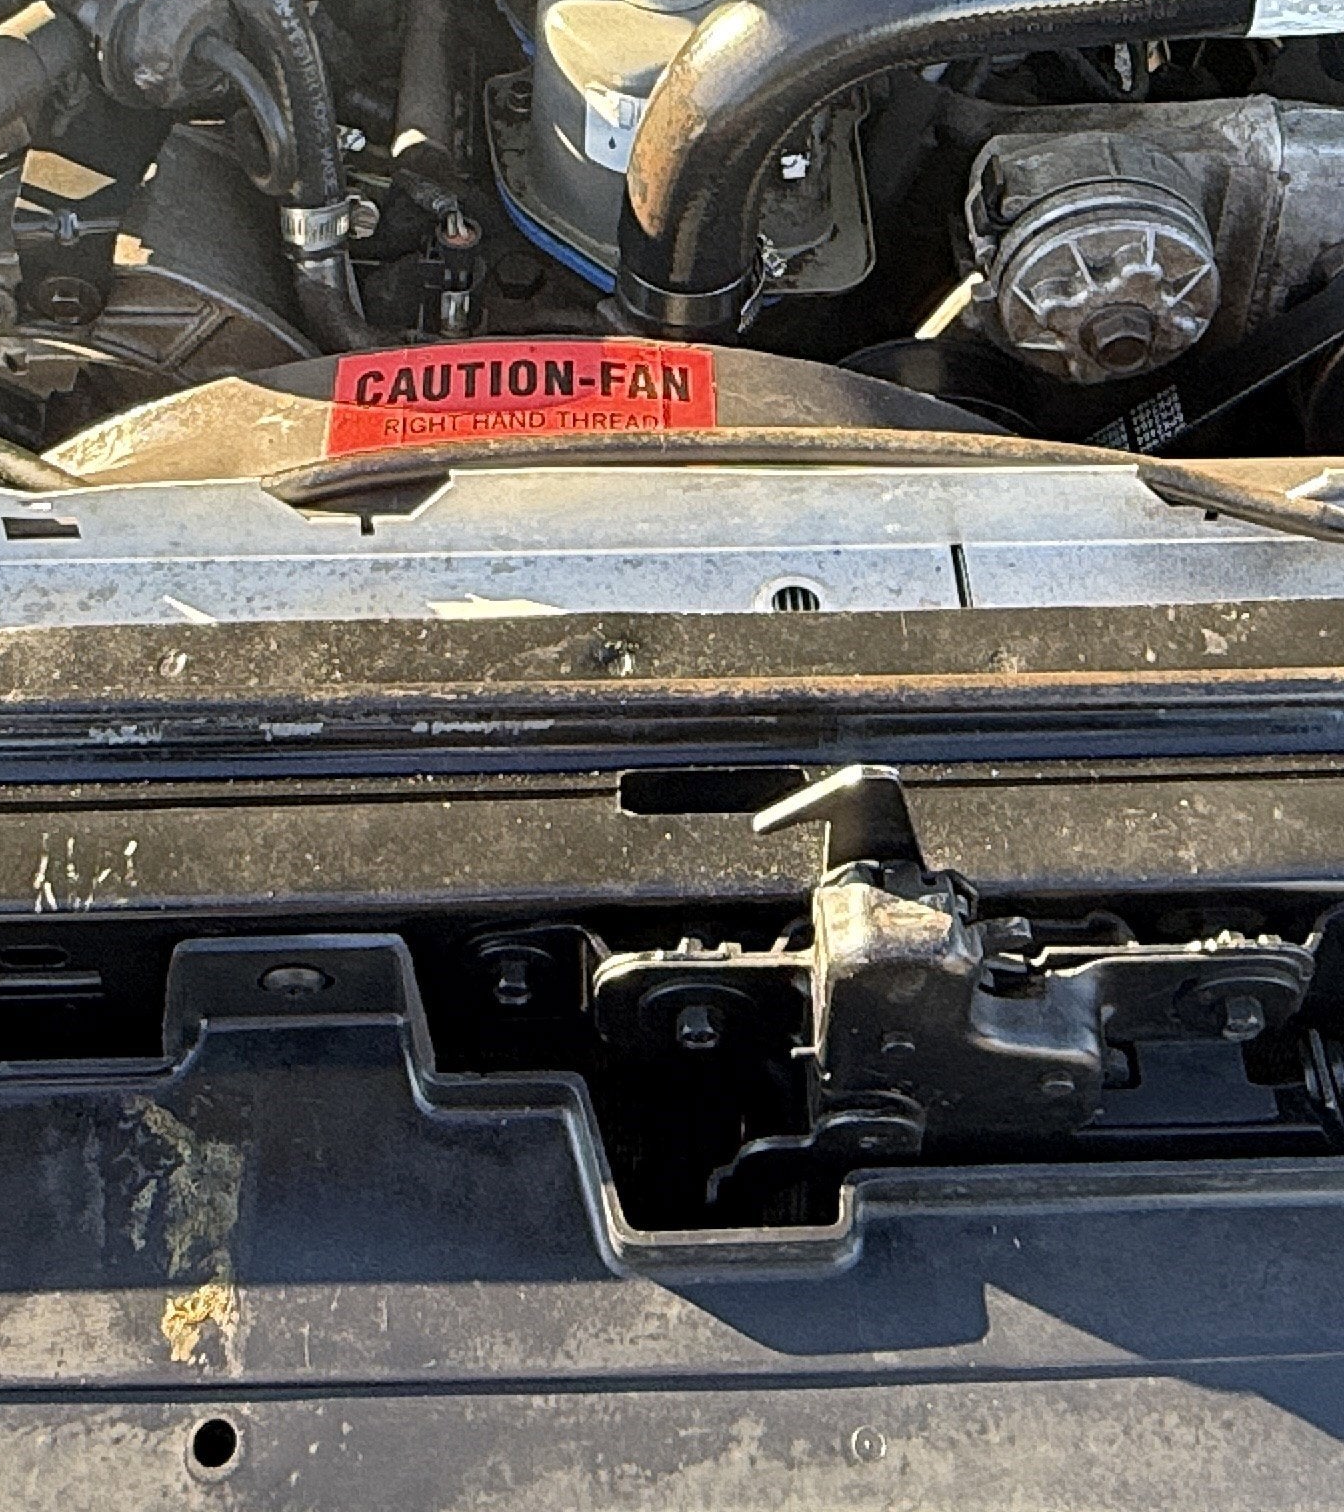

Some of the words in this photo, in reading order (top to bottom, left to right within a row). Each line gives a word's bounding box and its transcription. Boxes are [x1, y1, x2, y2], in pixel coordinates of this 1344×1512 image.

[356, 359, 690, 405] CAUTION-FAN
[384, 413, 460, 435] RIGHT
[472, 411, 545, 431] HAND
[556, 410, 660, 431] THREAD
